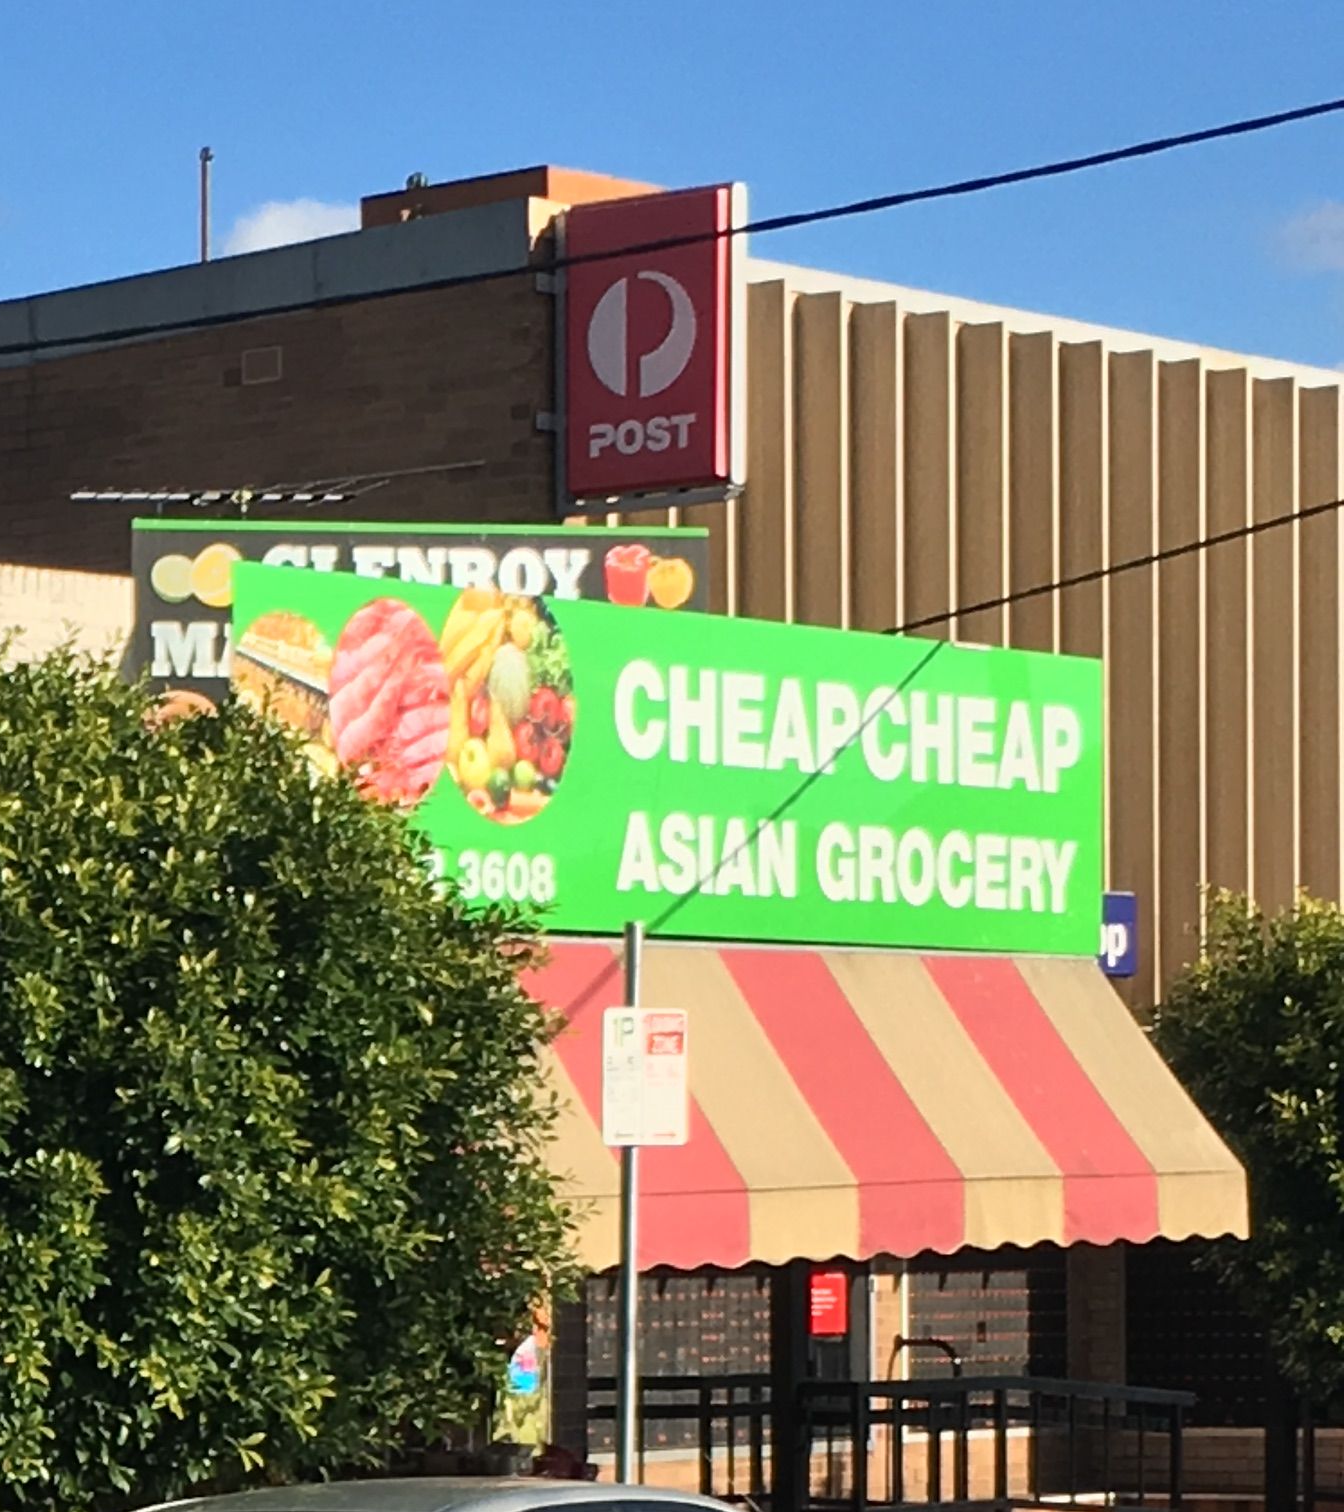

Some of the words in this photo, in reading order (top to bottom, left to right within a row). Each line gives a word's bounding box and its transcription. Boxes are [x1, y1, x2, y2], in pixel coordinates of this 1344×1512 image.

[588, 412, 697, 459] POST
[457, 848, 557, 903] 3608
[615, 810, 799, 899] ASIAN
[816, 821, 1079, 915] GROCERY
